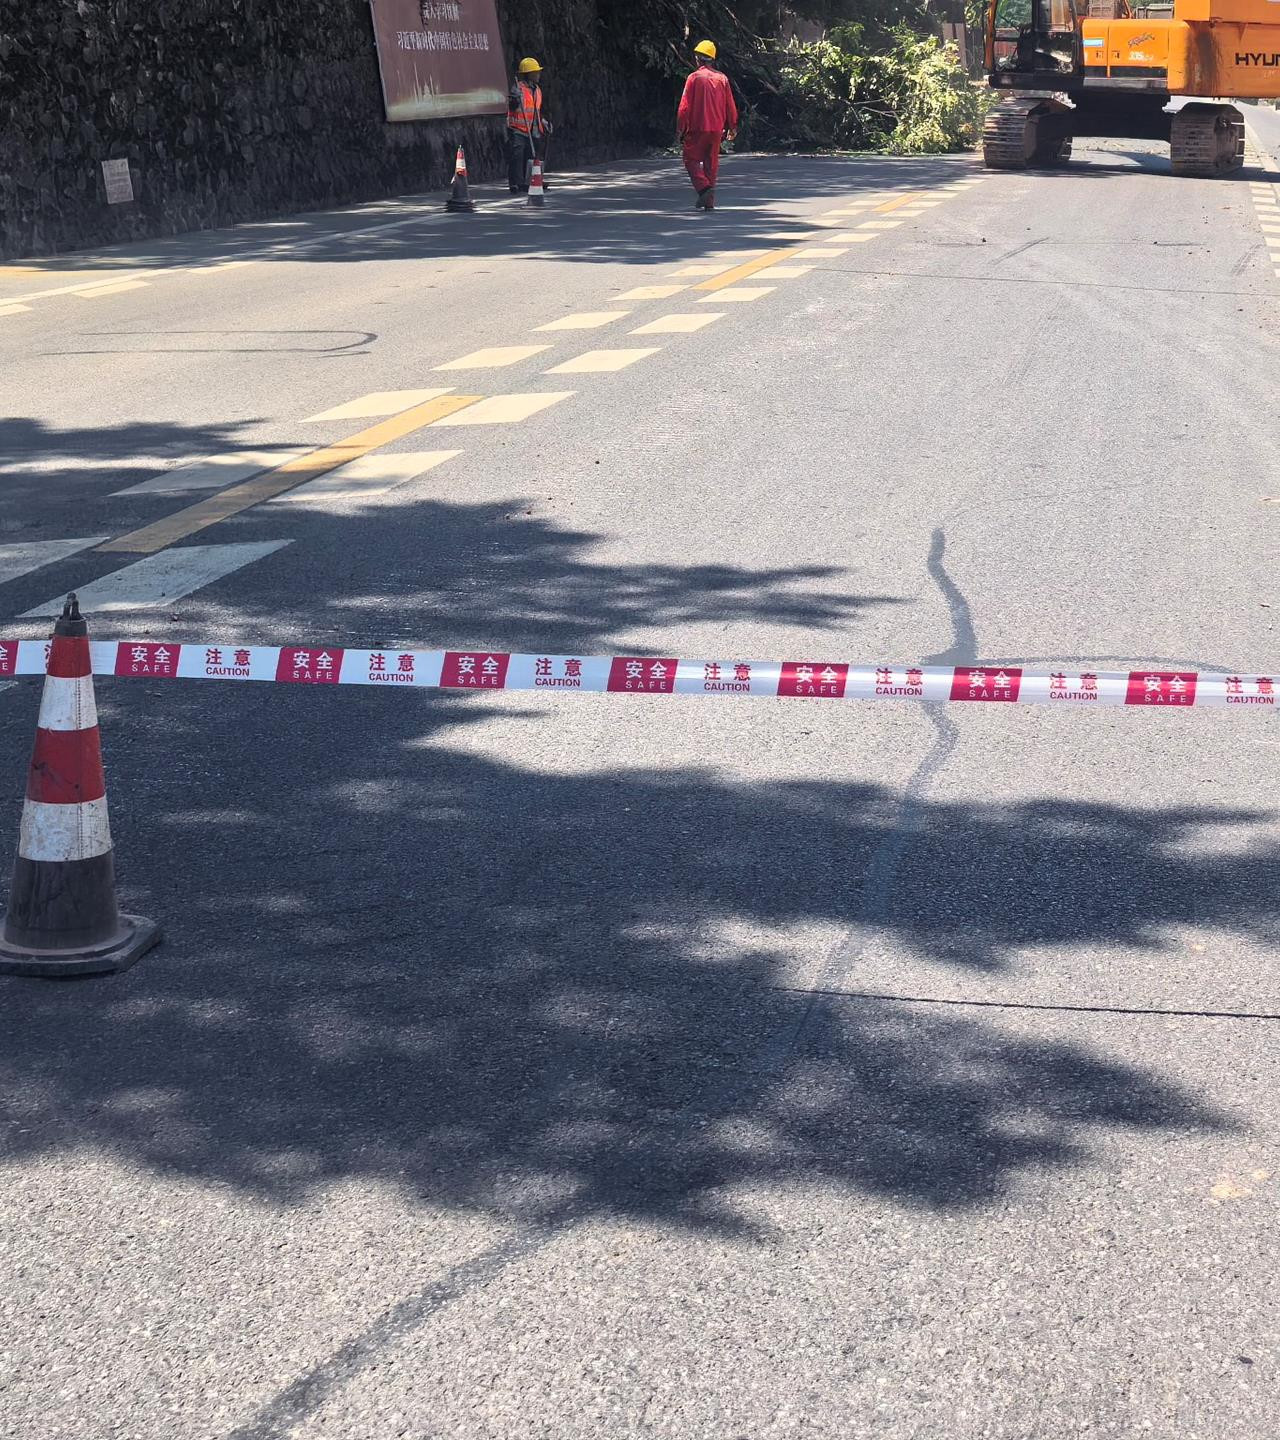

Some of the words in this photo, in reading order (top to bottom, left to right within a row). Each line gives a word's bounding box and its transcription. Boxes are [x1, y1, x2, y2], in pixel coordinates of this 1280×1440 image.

[132, 646, 171, 663] 安全
[205, 649, 251, 666] 注意
[293, 652, 333, 669] 安全
[132, 664, 171, 673] SAFE
[369, 654, 414, 671] 注意
[458, 656, 499, 674] 安全
[536, 658, 582, 676] 注意
[626, 660, 668, 678] 安全
[206, 667, 250, 677] CAUTION
[294, 670, 332, 680] SAFE
[369, 672, 414, 682] CAUTION
[704, 663, 751, 680] 注意
[796, 665, 838, 683] 安全
[876, 667, 923, 685] 注意
[458, 675, 498, 685] SAFE
[535, 678, 581, 687] CAUTION
[626, 680, 666, 690] SAFE
[969, 670, 1011, 688] 安全
[1050, 672, 1098, 690] 注意
[1144, 675, 1187, 691] 安全
[1225, 677, 1274, 694] 注意
[704, 682, 750, 692] CAUTION
[796, 685, 837, 694] SAFE
[875, 687, 922, 696] CAUTION
[969, 690, 1011, 699] SAFE
[1050, 691, 1098, 700] CAUTION
[1144, 693, 1187, 703] SAFE
[1226, 695, 1274, 705] CAUTION
